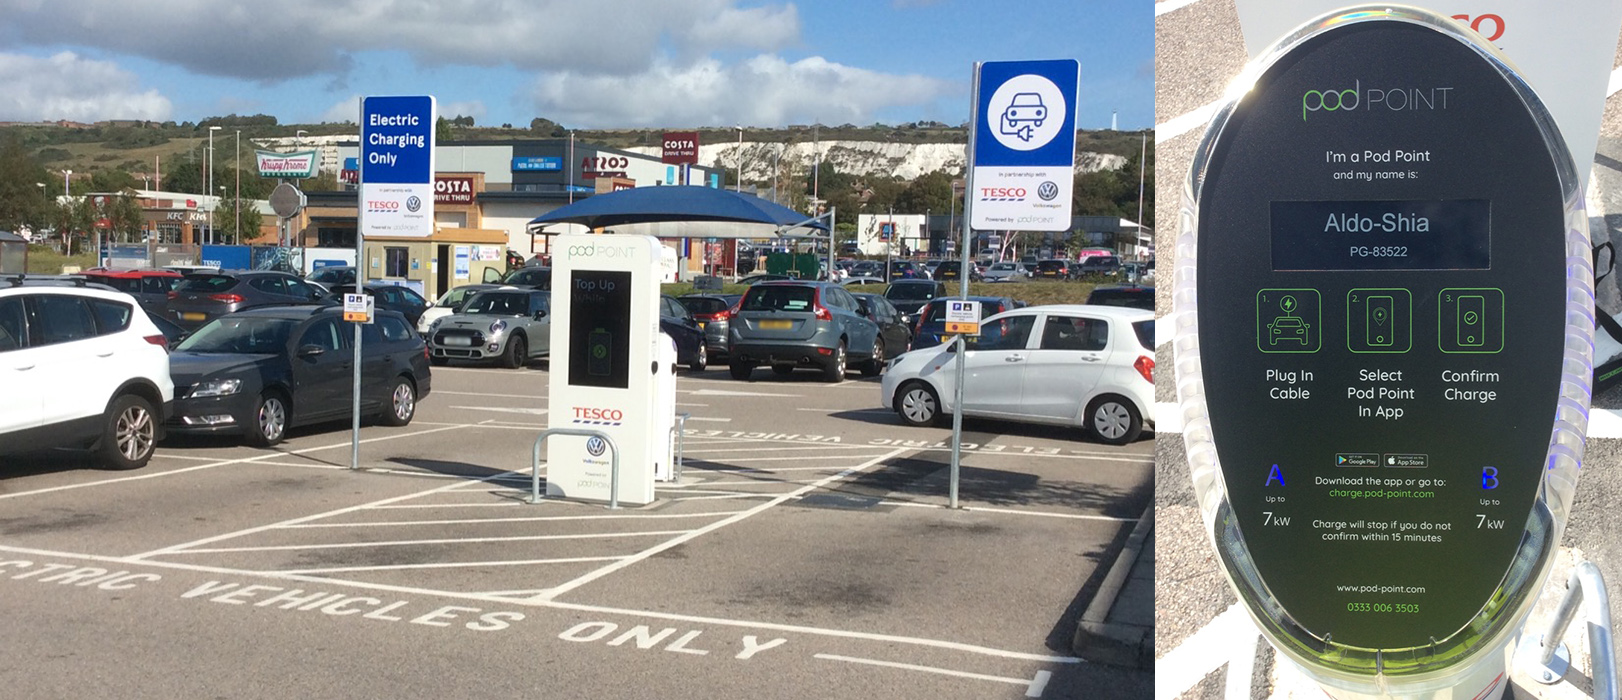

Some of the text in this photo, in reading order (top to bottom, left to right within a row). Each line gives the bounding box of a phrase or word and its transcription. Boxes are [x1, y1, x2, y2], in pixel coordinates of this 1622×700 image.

[1303, 79, 1453, 122] pod POINT
[370, 114, 419, 126] Electric
[369, 133, 425, 148] Charging
[664, 140, 694, 149] COSTA
[369, 152, 398, 166] Only
[1326, 150, 1430, 163] I'm a Pod Point
[1333, 170, 1418, 181] and my name is:
[434, 181, 470, 193] OSTA
[981, 188, 1027, 197] TESCO
[367, 201, 399, 209] TESCO
[167, 212, 184, 220] KFC
[1324, 213, 1430, 232] Aldo-Shia
[568, 242, 636, 260] pod POINT
[1350, 247, 1408, 257] PG-83522
[575, 278, 615, 293] Top Up
[1266, 369, 1313, 384] Plug In
[1359, 369, 1402, 382] Select
[1441, 370, 1500, 382] Confirm
[1269, 387, 1310, 399] Cable
[1348, 387, 1415, 399] Pod Point
[1444, 388, 1497, 403] Charge
[572, 407, 623, 421] TESCO
[1358, 405, 1404, 420] In App
[1265, 463, 1285, 487] A
[1482, 466, 1499, 489] B
[1315, 477, 1363, 485] Download
[1365, 477, 1381, 486] the
[1384, 479, 1402, 487] app
[1418, 479, 1431, 488] go
[1433, 478, 1447, 486] to:
[1329, 489, 1435, 499] charge.pod-point.com
[1312, 520, 1452, 531] Charge will stop if you do not
[1322, 532, 1442, 542] confirm within 15 minutes
[1336, 585, 1426, 594] www.pod-point.com
[1347, 603, 1420, 613] 0333 006 3503
[180, 580, 526, 631] VEHICLES
[557, 621, 788, 660] ONLY
